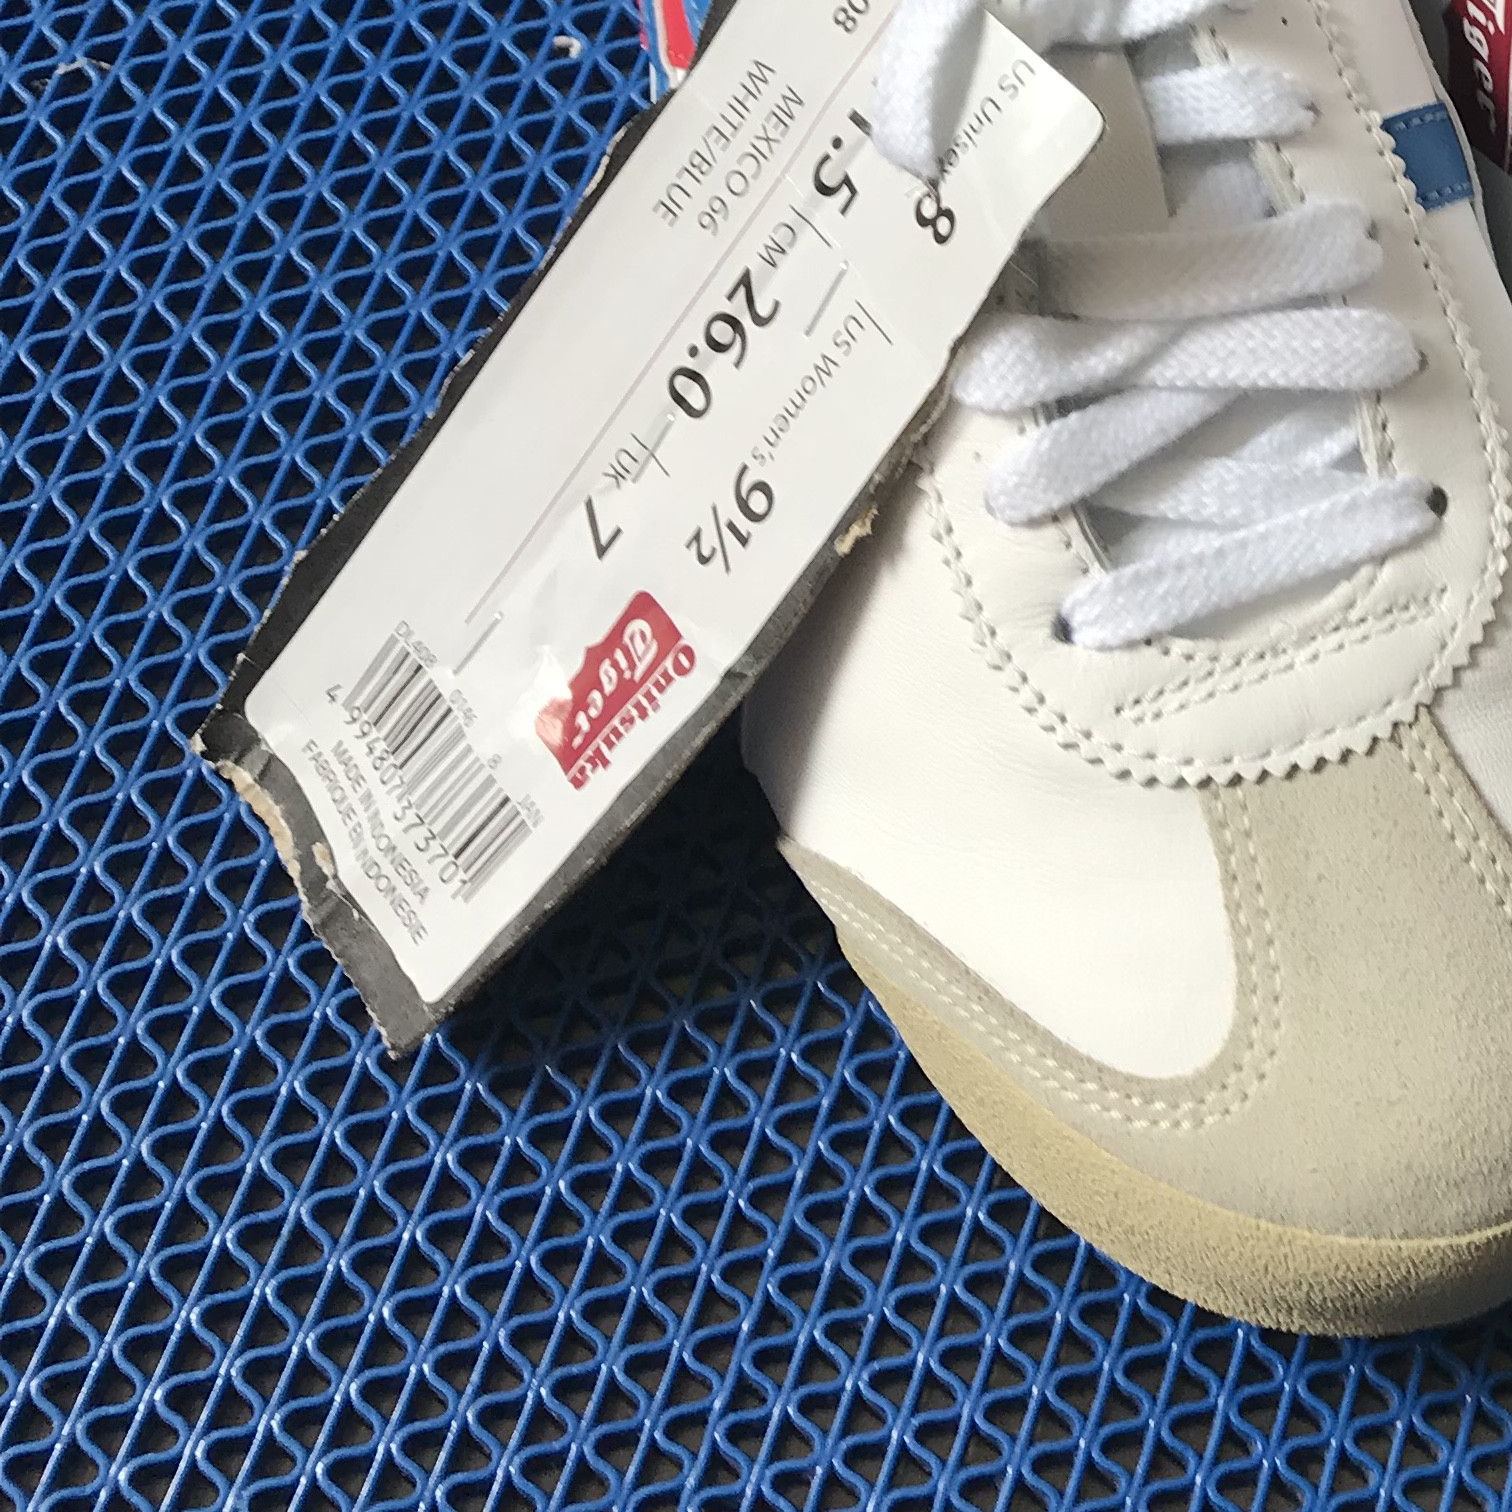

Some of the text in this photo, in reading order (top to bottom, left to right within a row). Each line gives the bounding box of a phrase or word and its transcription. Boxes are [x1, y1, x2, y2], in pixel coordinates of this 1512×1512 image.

[998, 58, 1036, 102] US
[652, 58, 777, 228] WHITE/BLUE
[697, 84, 805, 236] MEXICO 66
[757, 221, 798, 269] CM
[667, 265, 782, 420] 26.0
[833, 314, 866, 358] US
[750, 352, 841, 467] Women's
[602, 448, 638, 489] UK
[584, 494, 624, 561] 7
[567, 643, 697, 791] Onitsuka
[571, 618, 659, 750] Tiger
